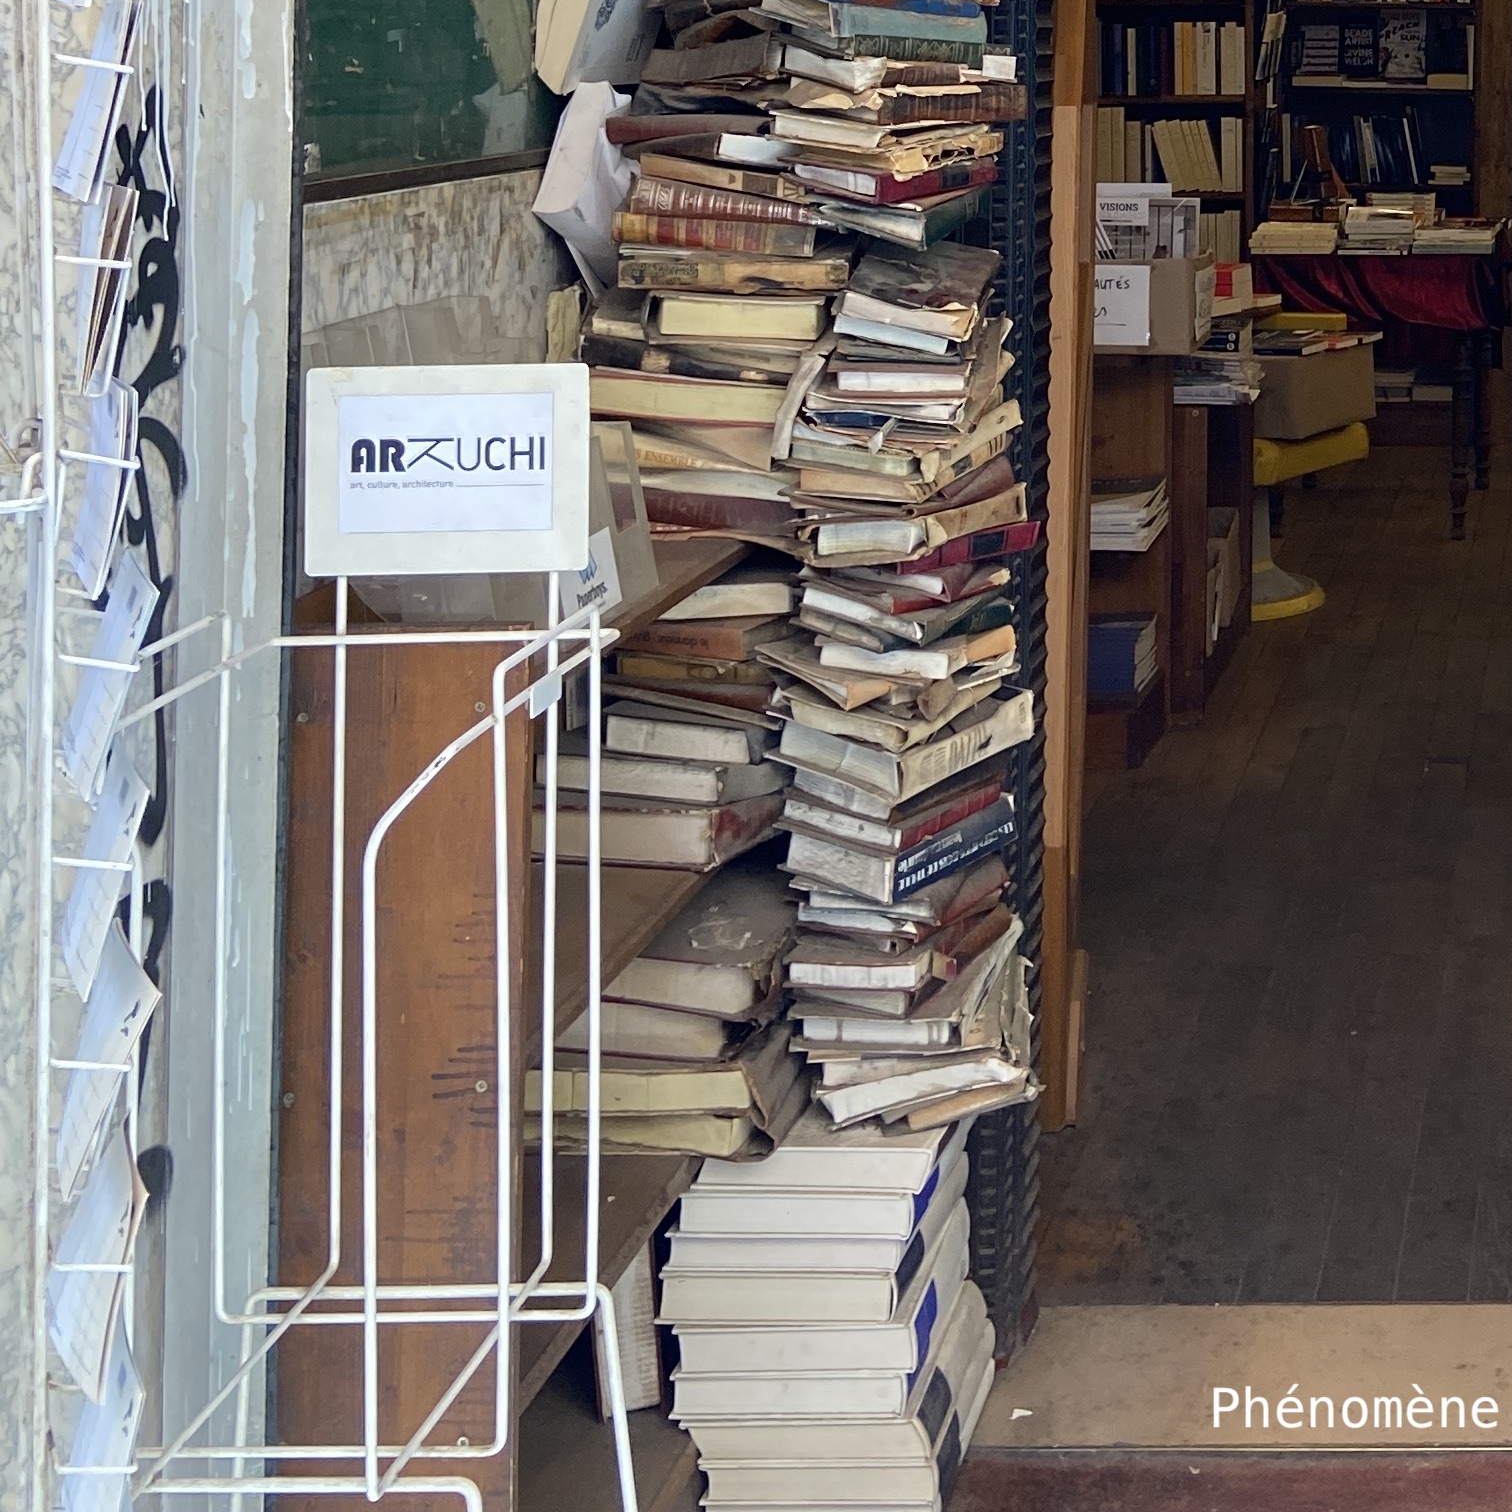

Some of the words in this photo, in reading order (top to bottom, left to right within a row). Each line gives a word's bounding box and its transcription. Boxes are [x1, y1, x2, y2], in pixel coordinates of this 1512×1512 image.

[1344, 29, 1373, 38] BLADE
[1344, 57, 1373, 66] WELSH
[1099, 202, 1139, 212] VISIONS
[643, 448, 699, 469] ENSEMBLE
